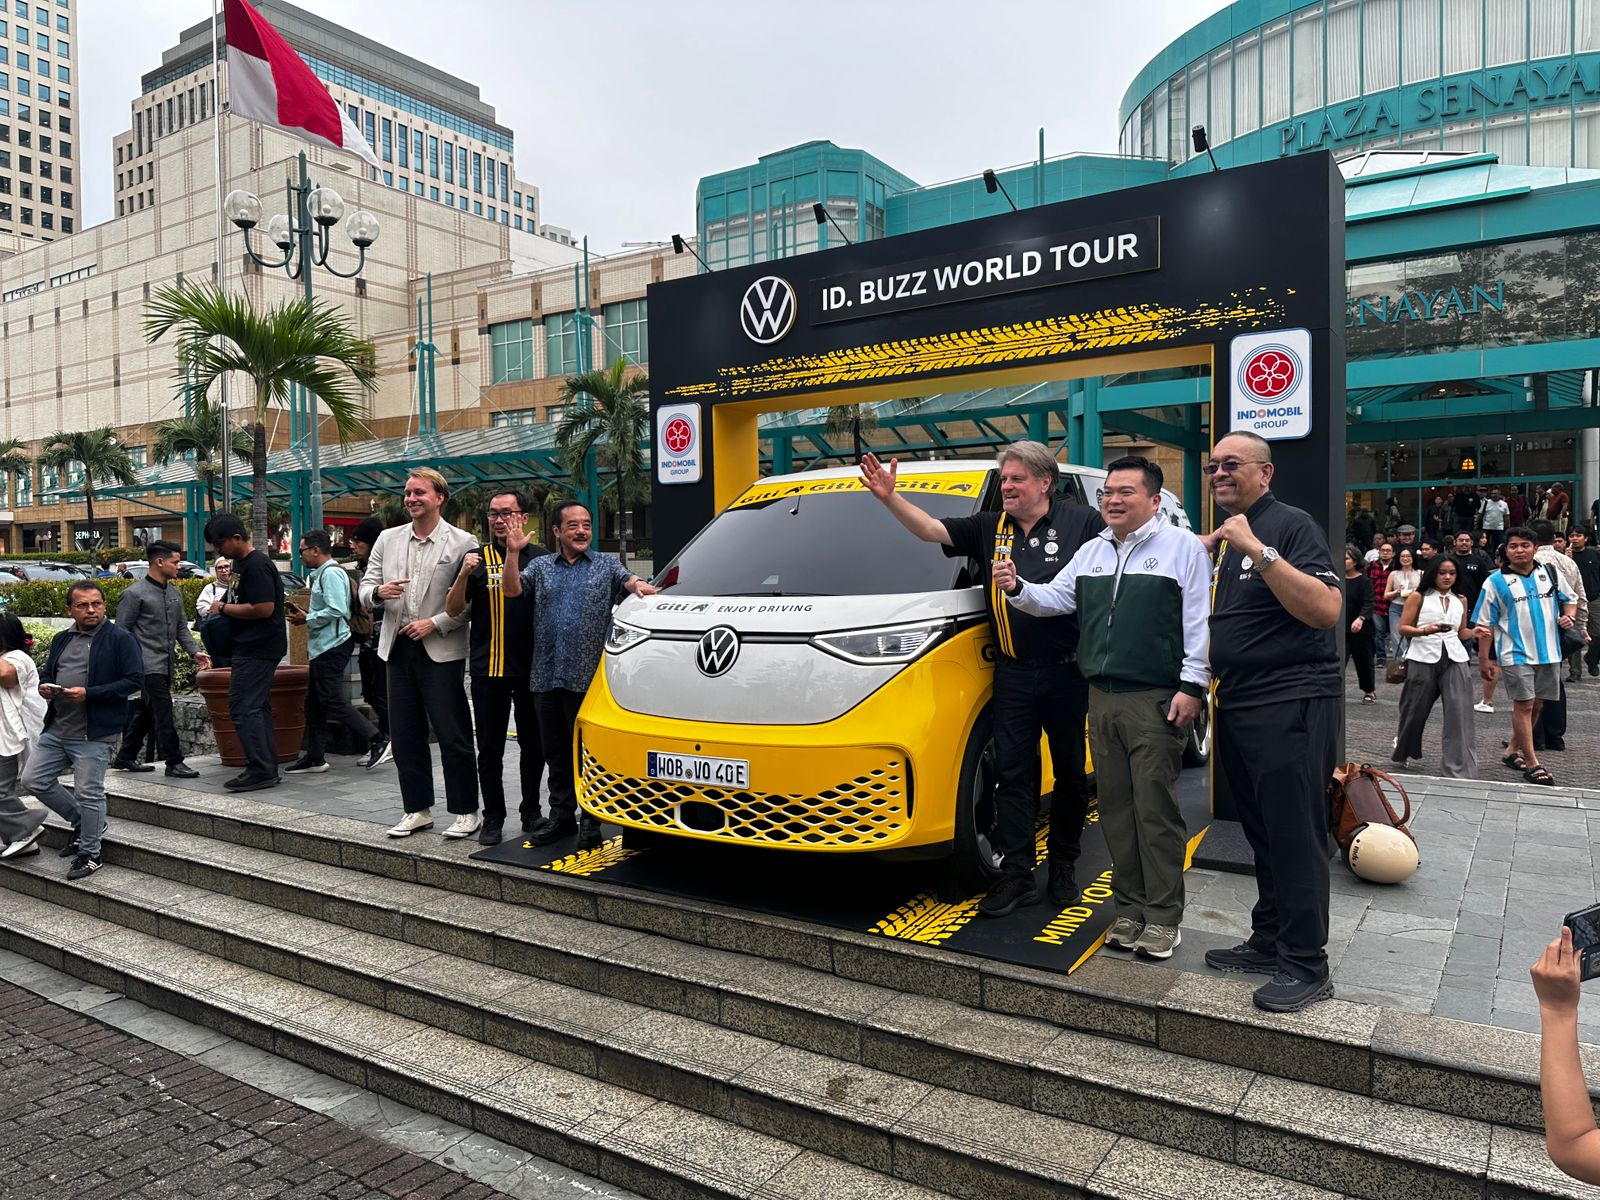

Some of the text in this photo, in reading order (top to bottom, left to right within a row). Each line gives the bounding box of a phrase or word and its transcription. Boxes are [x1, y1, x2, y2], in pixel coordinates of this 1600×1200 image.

[1280, 61, 1600, 156] PLAZA SENAYA
[821, 232, 1139, 312] ID. BUZZ WORLD TOUR
[1237, 407, 1303, 420] INDOMOBIL
[1254, 420, 1288, 429] GROUP
[661, 459, 696, 468] INDOMOBIL
[670, 468, 689, 476] GROUP
[809, 482, 855, 492] Giti
[740, 489, 780, 504] Giti
[656, 602, 690, 612] Giti
[717, 604, 814, 613] ENJOY DRIVING
[658, 756, 745, 784] WOB VO 40E
[1033, 906, 1093, 945] MIND
